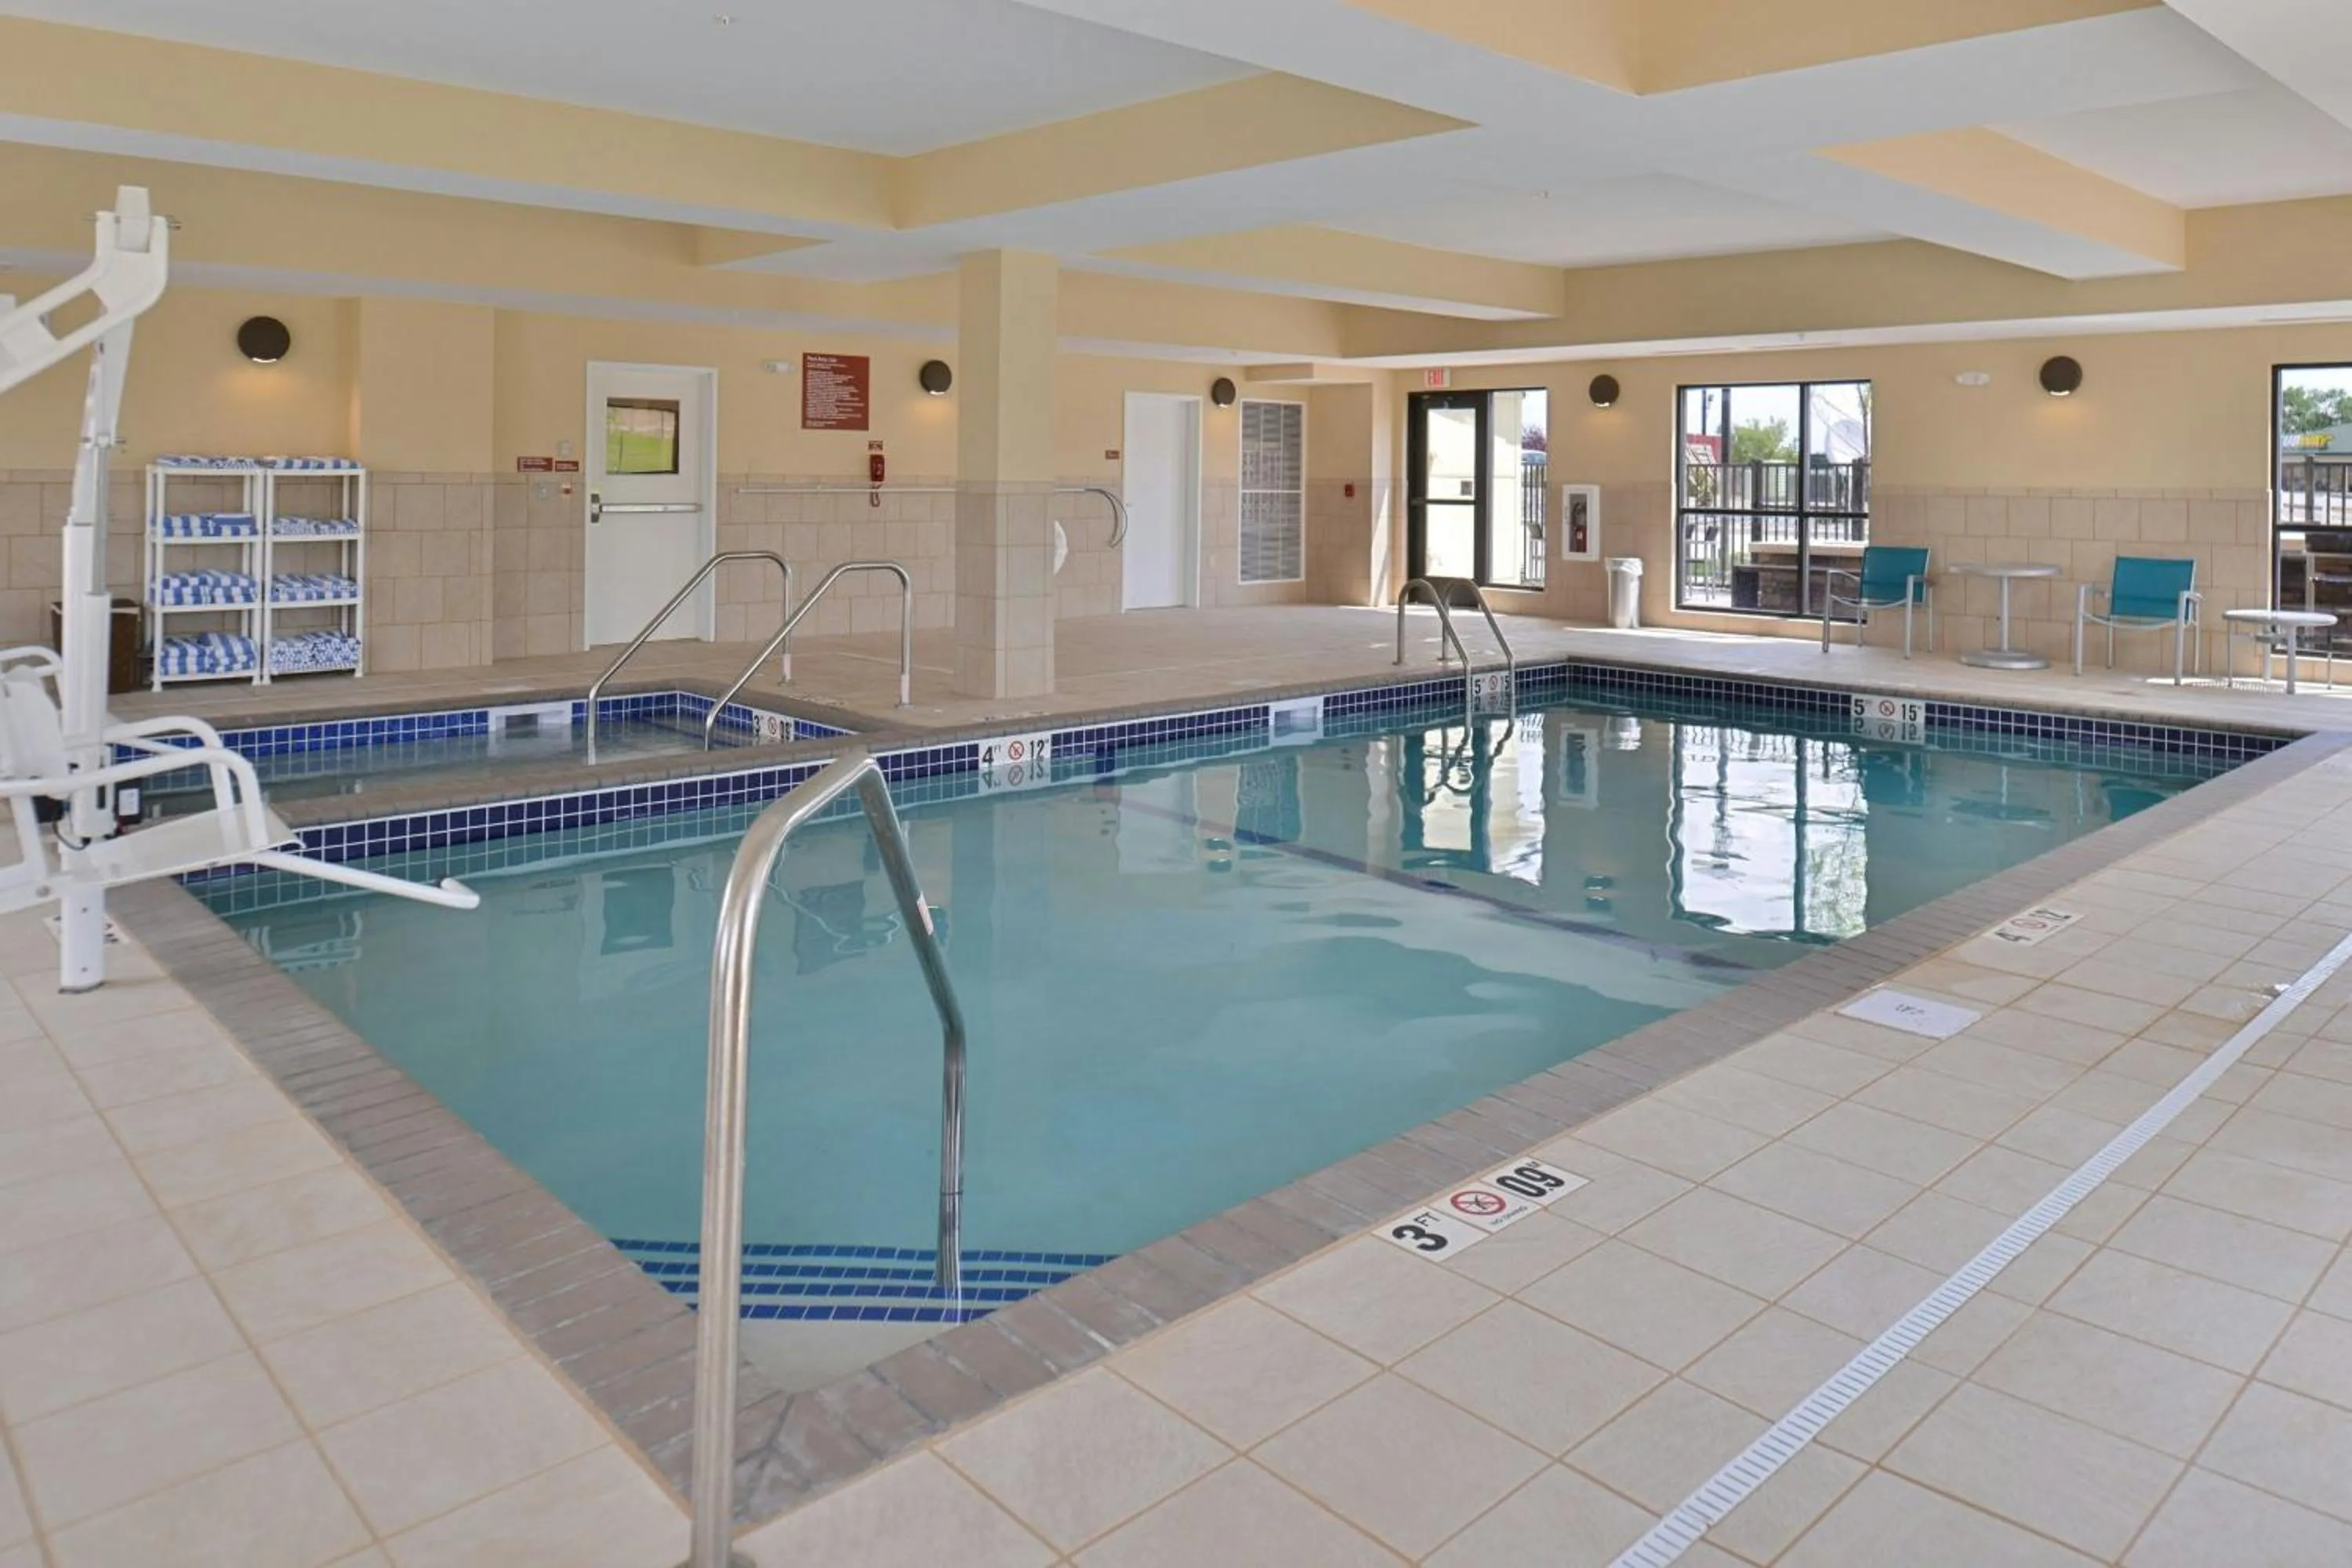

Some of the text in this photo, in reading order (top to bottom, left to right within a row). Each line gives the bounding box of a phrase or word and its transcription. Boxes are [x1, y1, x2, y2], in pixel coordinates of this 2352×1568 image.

[1474, 679, 1481, 694] 5
[1854, 699, 1917, 721] 5 15
[982, 746, 994, 764] 4
[1392, 1211, 1449, 1252] 3 FT
